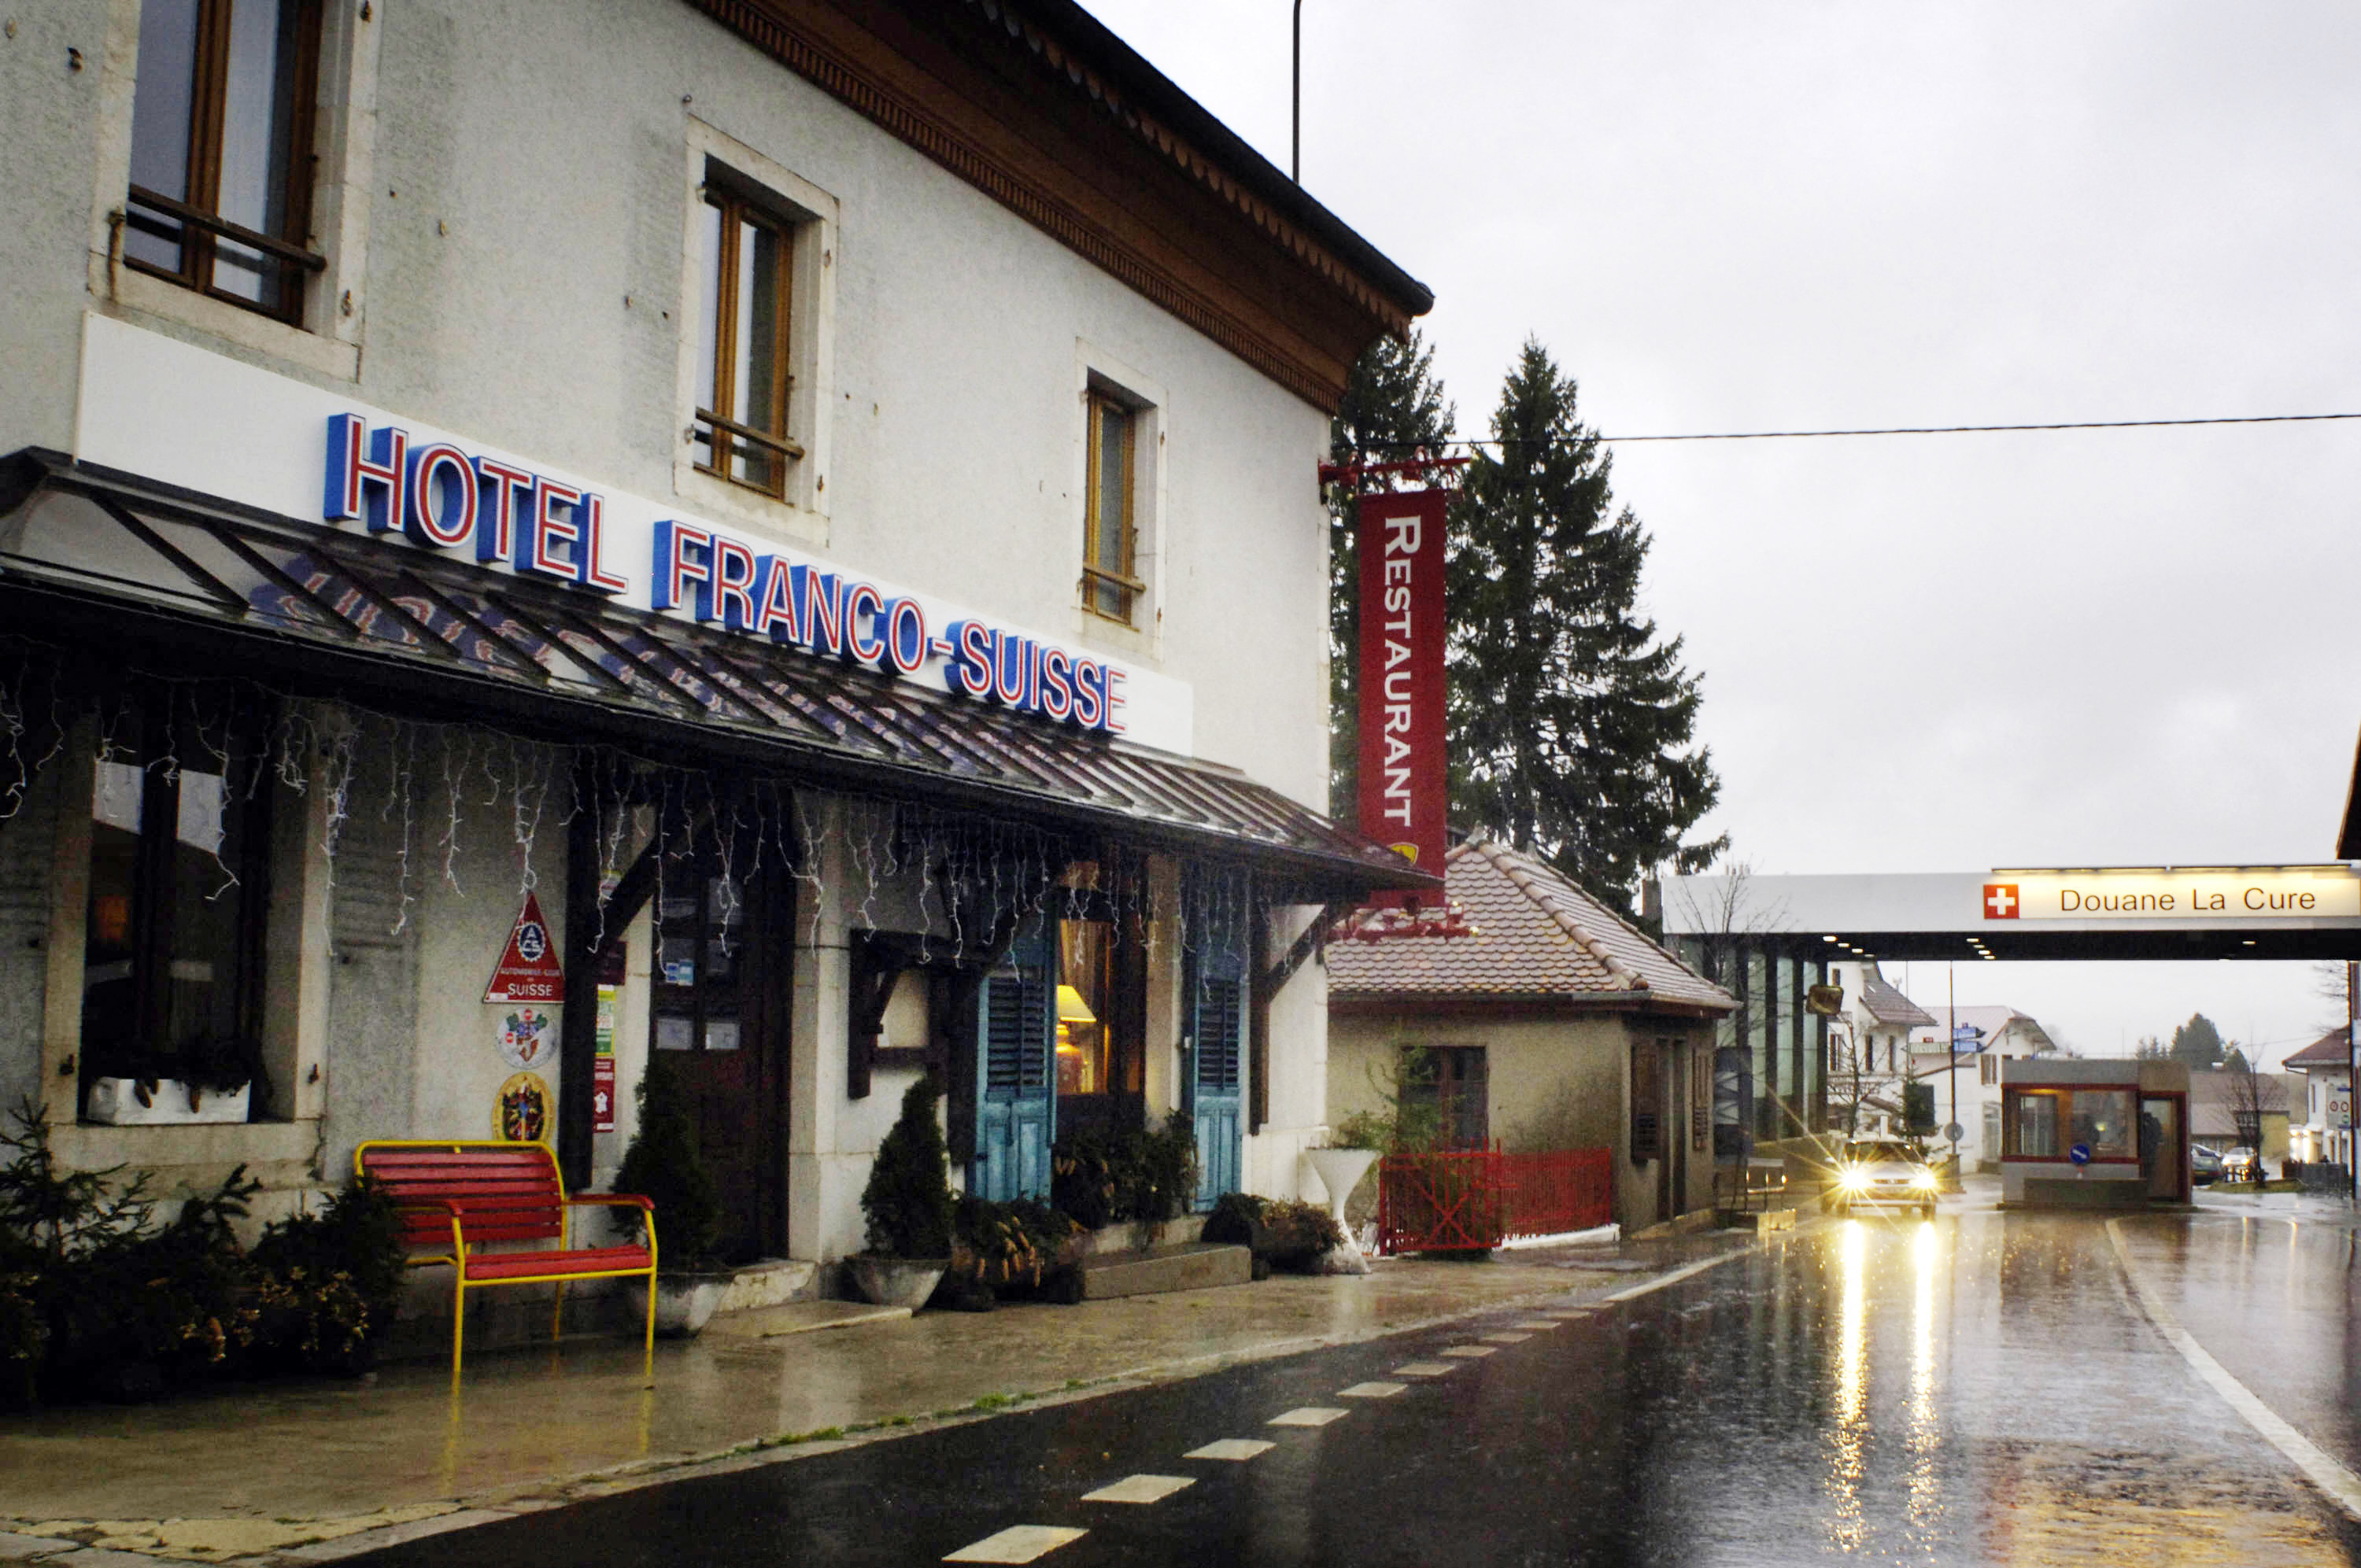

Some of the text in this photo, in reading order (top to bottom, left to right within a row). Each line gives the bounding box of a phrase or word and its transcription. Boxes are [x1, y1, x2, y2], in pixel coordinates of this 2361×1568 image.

[325, 412, 1128, 736] HOTEL FRANCO-SUISSE
[2060, 887, 2316, 912] Douane La Cure
[508, 983, 553, 997] SUISSE
